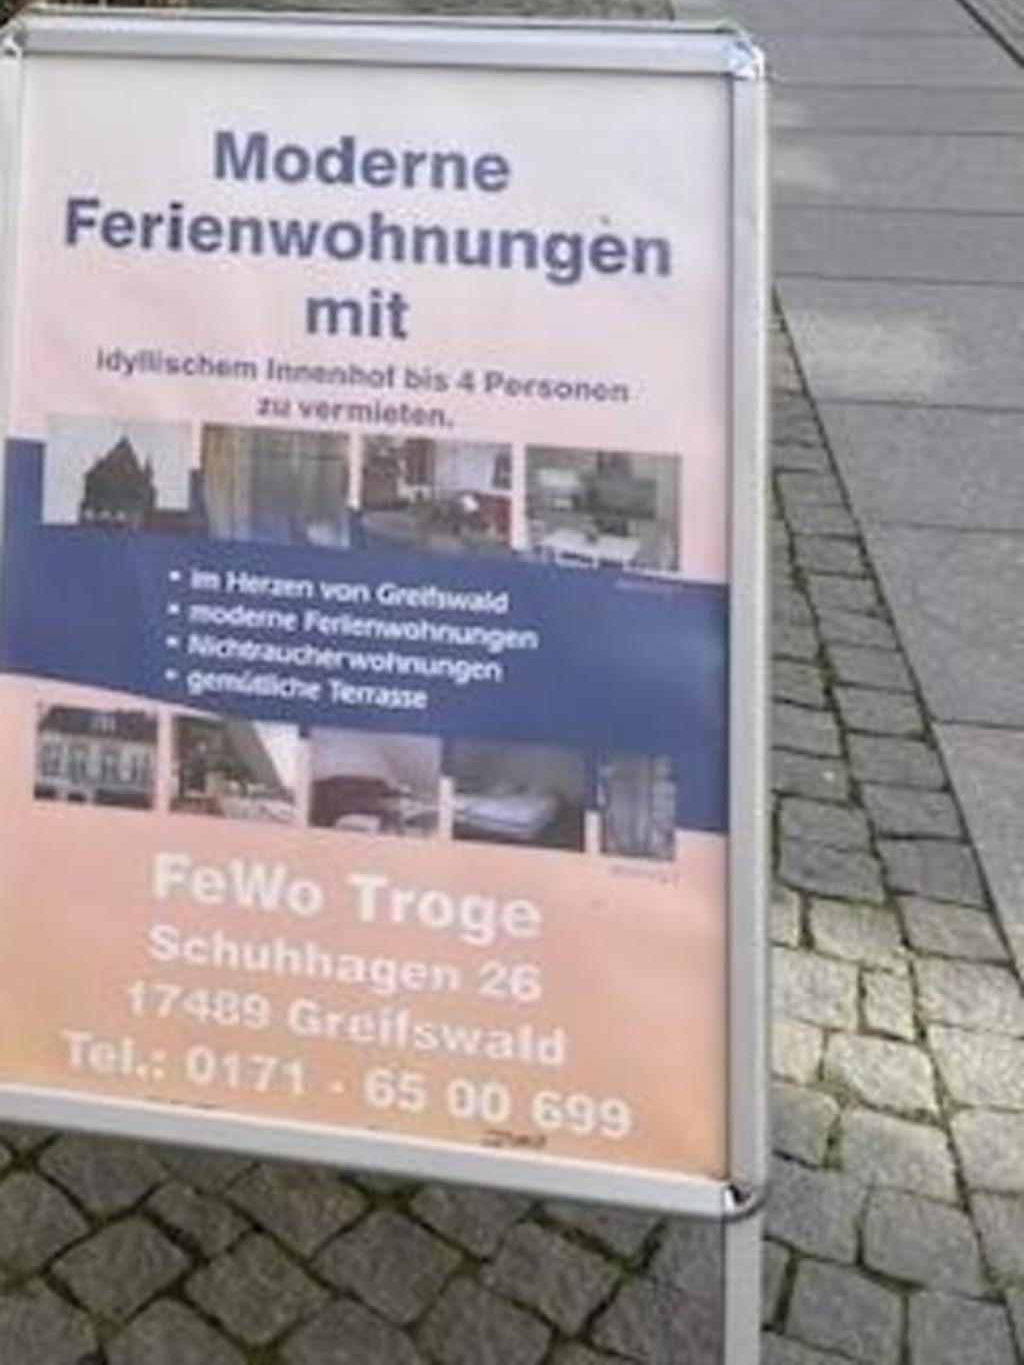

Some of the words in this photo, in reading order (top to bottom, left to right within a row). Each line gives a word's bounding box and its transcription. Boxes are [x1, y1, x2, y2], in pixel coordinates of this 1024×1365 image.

[214, 130, 510, 192] Moderne
[65, 196, 672, 285] Ferienwohnungen
[306, 288, 409, 340] mit
[267, 357, 395, 390] Innenhof
[404, 367, 449, 392] bis
[457, 371, 475, 392] 4
[485, 371, 629, 402] Personen
[257, 397, 290, 419] zu
[298, 398, 454, 428] vermieten.
[226, 570, 314, 598] Herzen
[320, 582, 370, 602] von
[377, 582, 509, 614] Greifswald
[190, 602, 298, 630] moderne
[306, 610, 539, 653] Ferienwohnungen
[188, 635, 503, 684] Nichtraucherwohnungen
[187, 669, 321, 701] gemütliche
[330, 680, 428, 710] Terrasse
[152, 852, 323, 916] FeWo
[348, 874, 543, 946] Troge
[148, 925, 461, 994] Schuhhagen
[479, 961, 543, 1001] 26
[128, 981, 272, 1028] 17489
[289, 998, 566, 1066] Greifswald
[63, 1029, 166, 1079] Tel.:
[185, 1045, 307, 1094] 0171
[365, 1068, 426, 1112] 65
[446, 1079, 512, 1123] 00
[532, 1090, 632, 1139] 699
